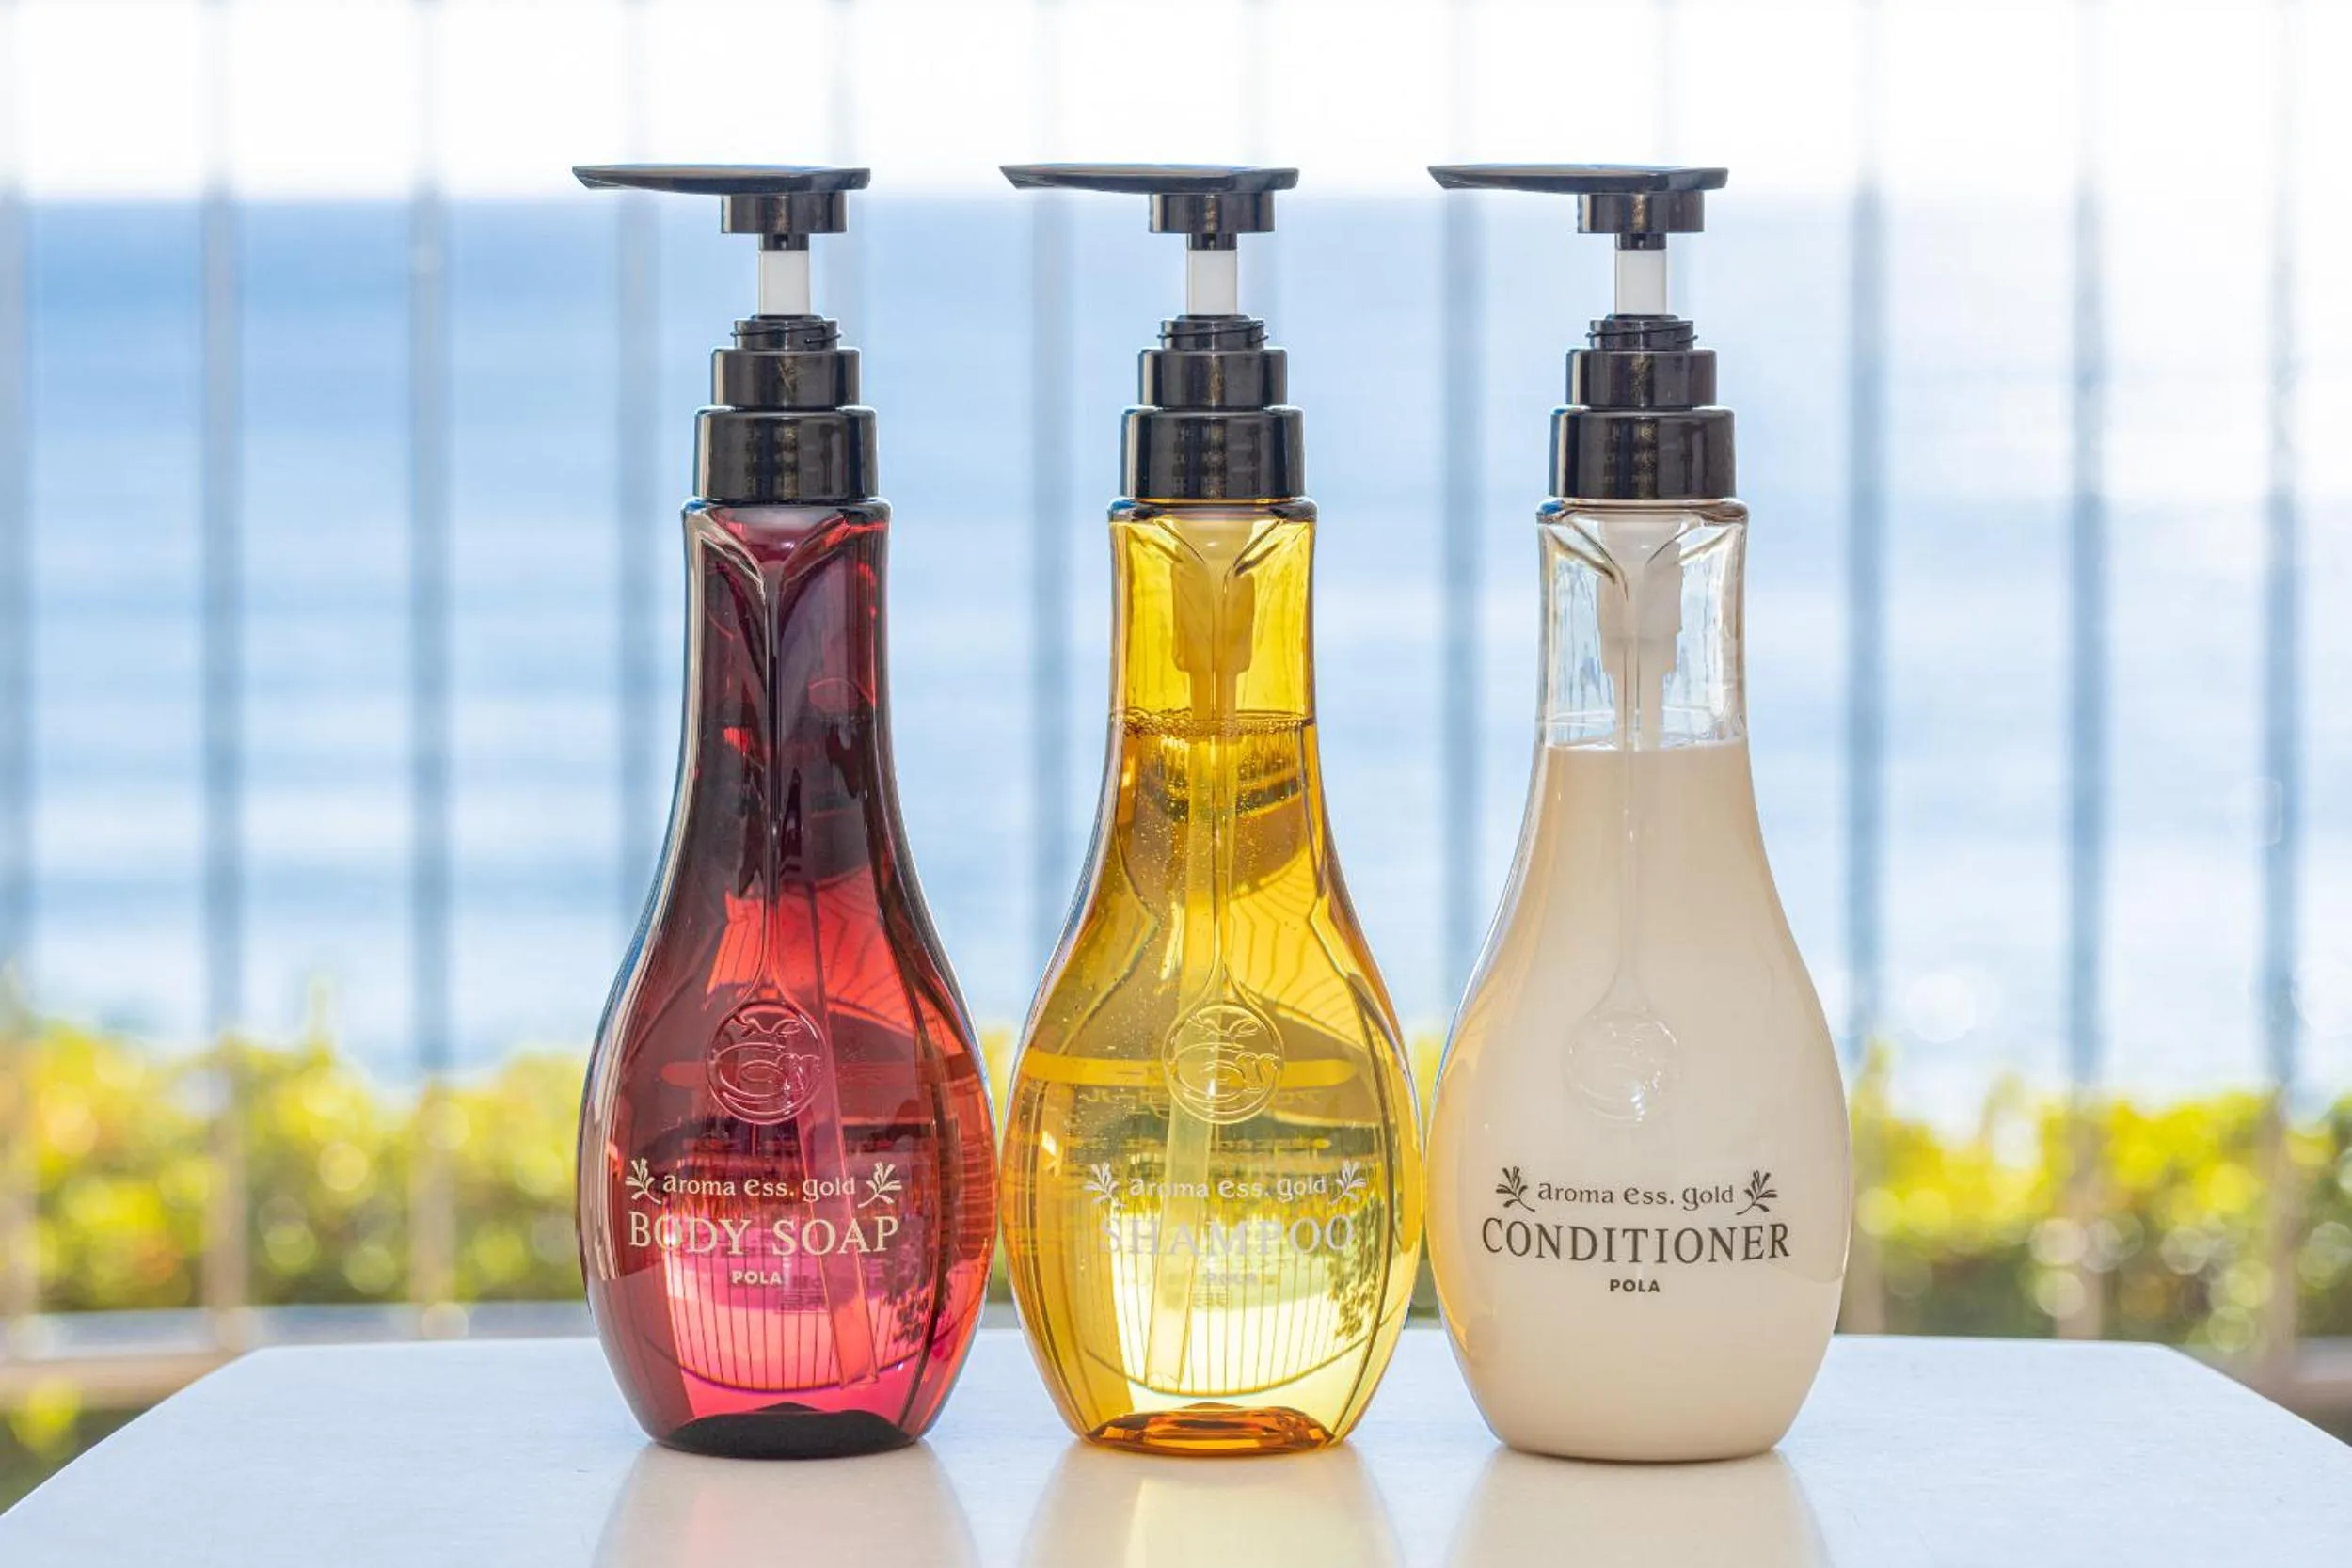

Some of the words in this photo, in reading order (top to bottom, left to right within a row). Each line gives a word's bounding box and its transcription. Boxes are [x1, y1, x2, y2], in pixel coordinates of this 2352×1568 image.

[662, 1174, 736, 1196] aroma
[743, 1178, 795, 1197] ess.
[802, 1177, 856, 1202] gold
[1128, 1178, 1209, 1197] aroma
[1217, 1178, 1270, 1199] ess.
[1277, 1176, 1327, 1202] gold
[1537, 1182, 1614, 1203] aroma
[1623, 1183, 1675, 1205] ess.
[1681, 1185, 1735, 1211] gold
[628, 1212, 754, 1255] BODY
[772, 1215, 900, 1256] SOAP
[1100, 1212, 1355, 1257] SHAMPOO
[1482, 1216, 1791, 1265] CONDITIONER
[731, 1270, 785, 1286] POLA
[1609, 1278, 1661, 1293] POLA
